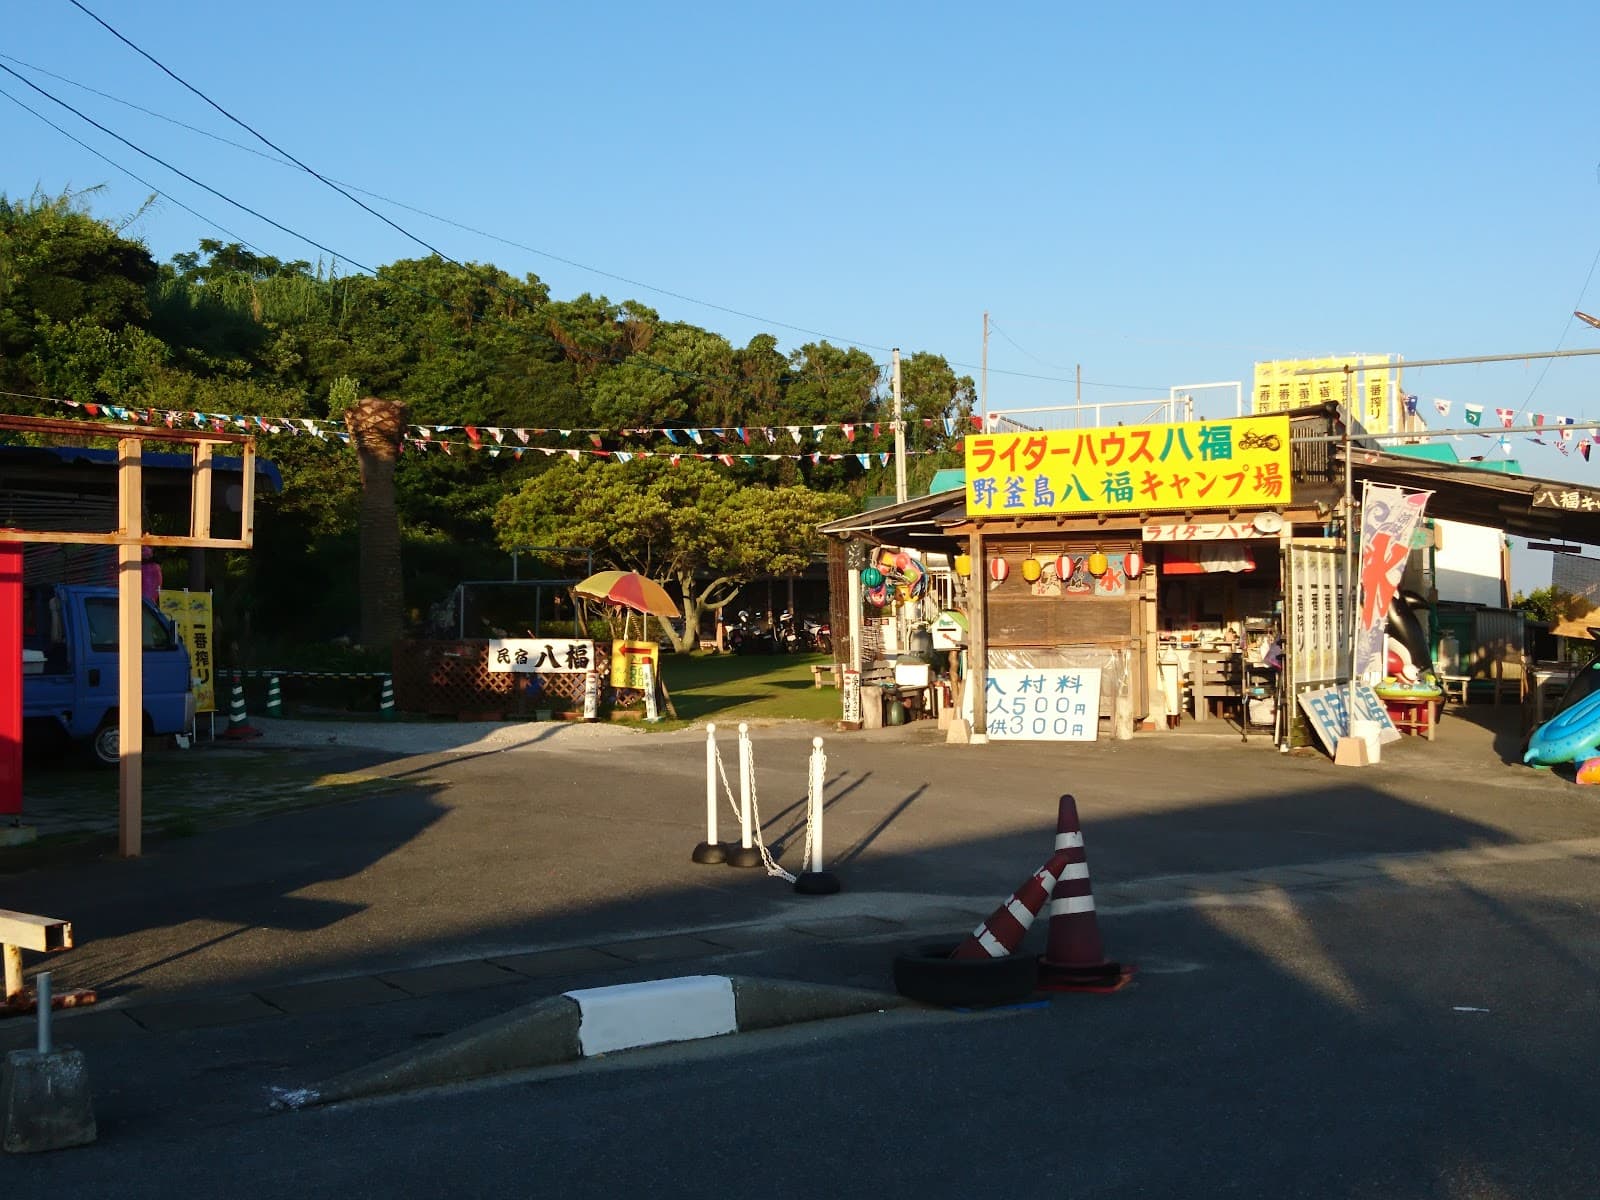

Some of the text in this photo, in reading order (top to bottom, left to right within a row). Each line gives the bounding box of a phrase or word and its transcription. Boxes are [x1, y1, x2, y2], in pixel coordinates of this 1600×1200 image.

[1370, 378, 1382, 420] 一番搾り
[972, 425, 1233, 472] ライダーハウス八福
[972, 462, 1283, 510] 野釜島八福キャンプ場
[1147, 522, 1281, 541] ライダーハウ
[193, 623, 210, 685] 一番搾り
[496, 644, 590, 670] 民宿八福
[985, 674, 1083, 695] 入村料
[970, 697, 1086, 716] 人500円
[970, 715, 1084, 736] 供300円
